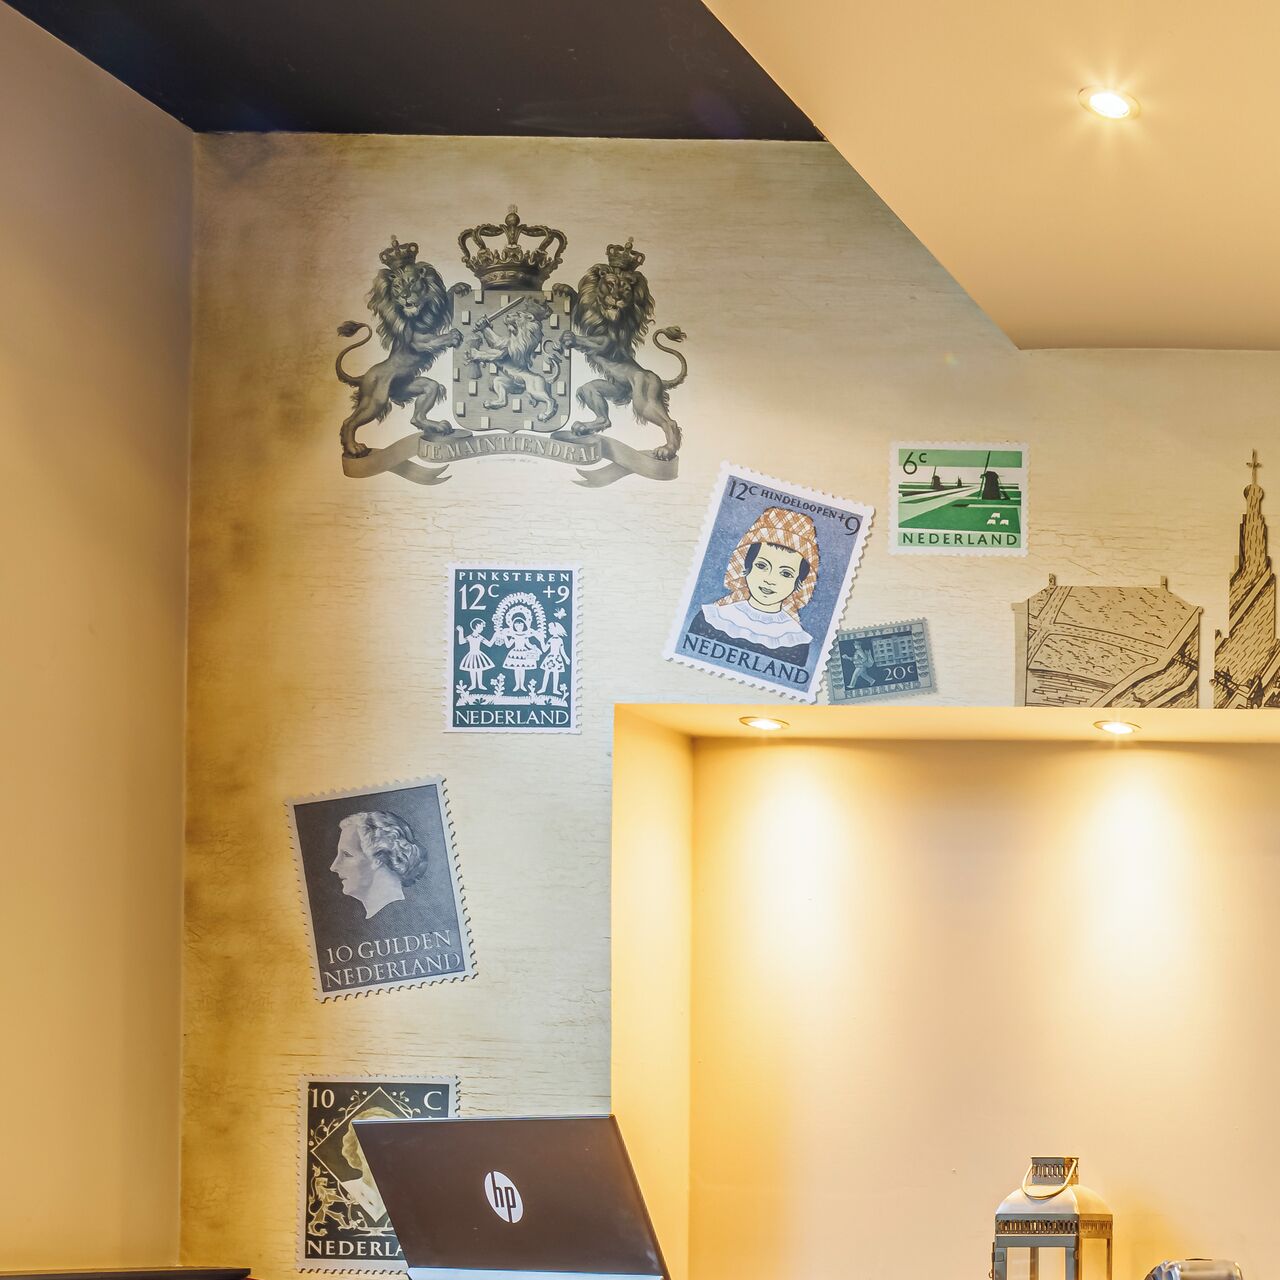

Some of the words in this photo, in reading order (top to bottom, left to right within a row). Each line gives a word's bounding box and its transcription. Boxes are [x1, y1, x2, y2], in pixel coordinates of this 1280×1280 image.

[422, 444, 442, 461] JE
[760, 489, 838, 519] HINDELOOPEN
[902, 532, 1018, 546] NEDERLAND
[458, 571, 570, 582] PINKSTEREN
[542, 585, 570, 604] +9
[682, 634, 810, 685] NEDERLAND
[455, 710, 569, 726] NEDERLAND
[326, 945, 353, 964] 10
[357, 929, 452, 959] GULDEN
[323, 952, 461, 988] NEDERLAND
[309, 1088, 335, 1109] 10
[423, 1091, 443, 1111] C
[488, 1171, 519, 1223] hp
